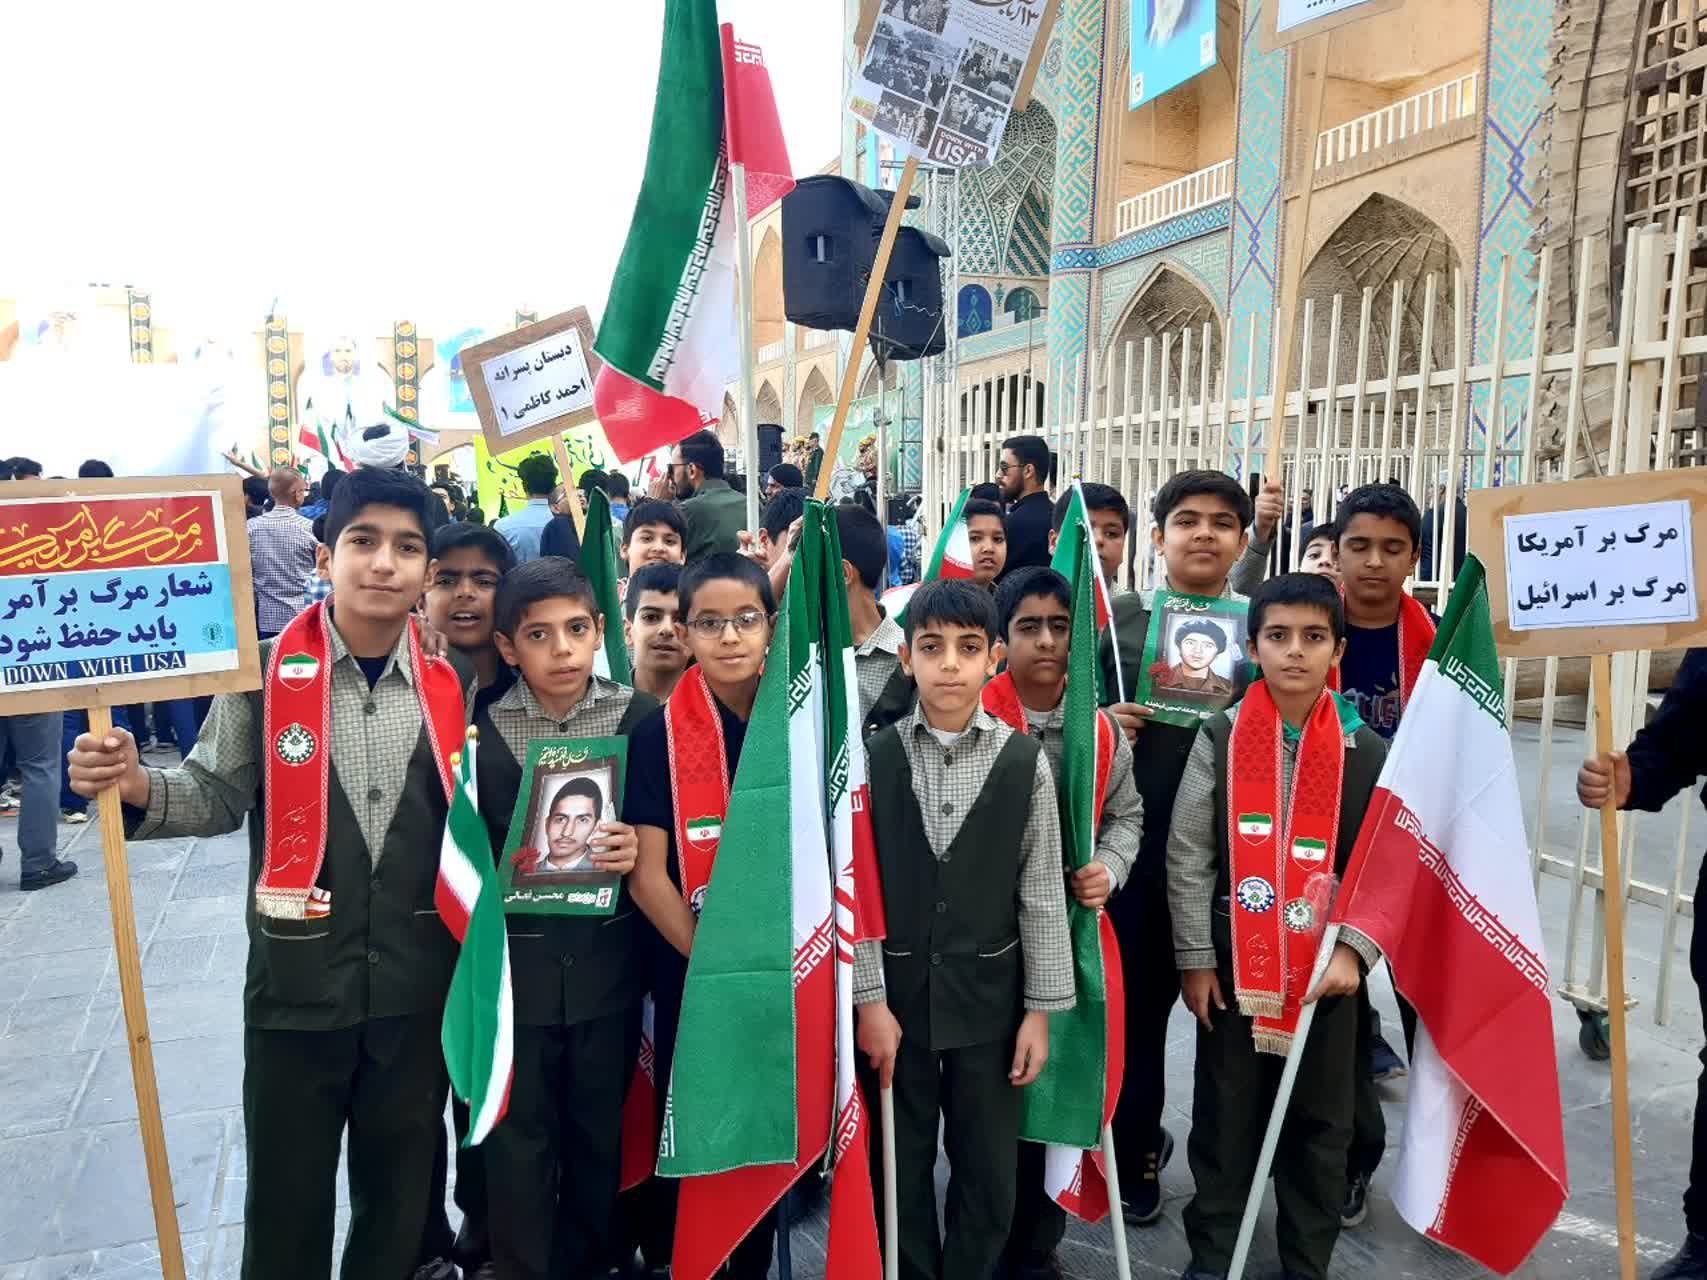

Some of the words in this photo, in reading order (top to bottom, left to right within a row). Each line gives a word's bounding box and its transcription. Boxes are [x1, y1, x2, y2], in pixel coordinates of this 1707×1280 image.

[935, 142, 978, 167] USA
[533, 344, 573, 372] دبستان
[554, 376, 589, 401] احمد
[513, 390, 552, 420] کاظمی
[1517, 525, 1588, 557] آمریکا
[1597, 531, 1617, 553] بر
[1624, 523, 1678, 549] مرگ
[2, 578, 50, 620] آمر
[53, 587, 78, 616] بر
[90, 576, 149, 611] مرگ
[155, 571, 213, 608] شعار
[1517, 580, 1597, 611] اسرائیل
[1605, 584, 1625, 606] بر
[1632, 578, 1687, 603] مرگ
[0, 626, 52, 663] شود
[57, 622, 122, 649] حفظ
[127, 615, 177, 648] باید
[5, 663, 68, 684] DOWN
[80, 657, 133, 678] WITH
[144, 650, 185, 670] USA
